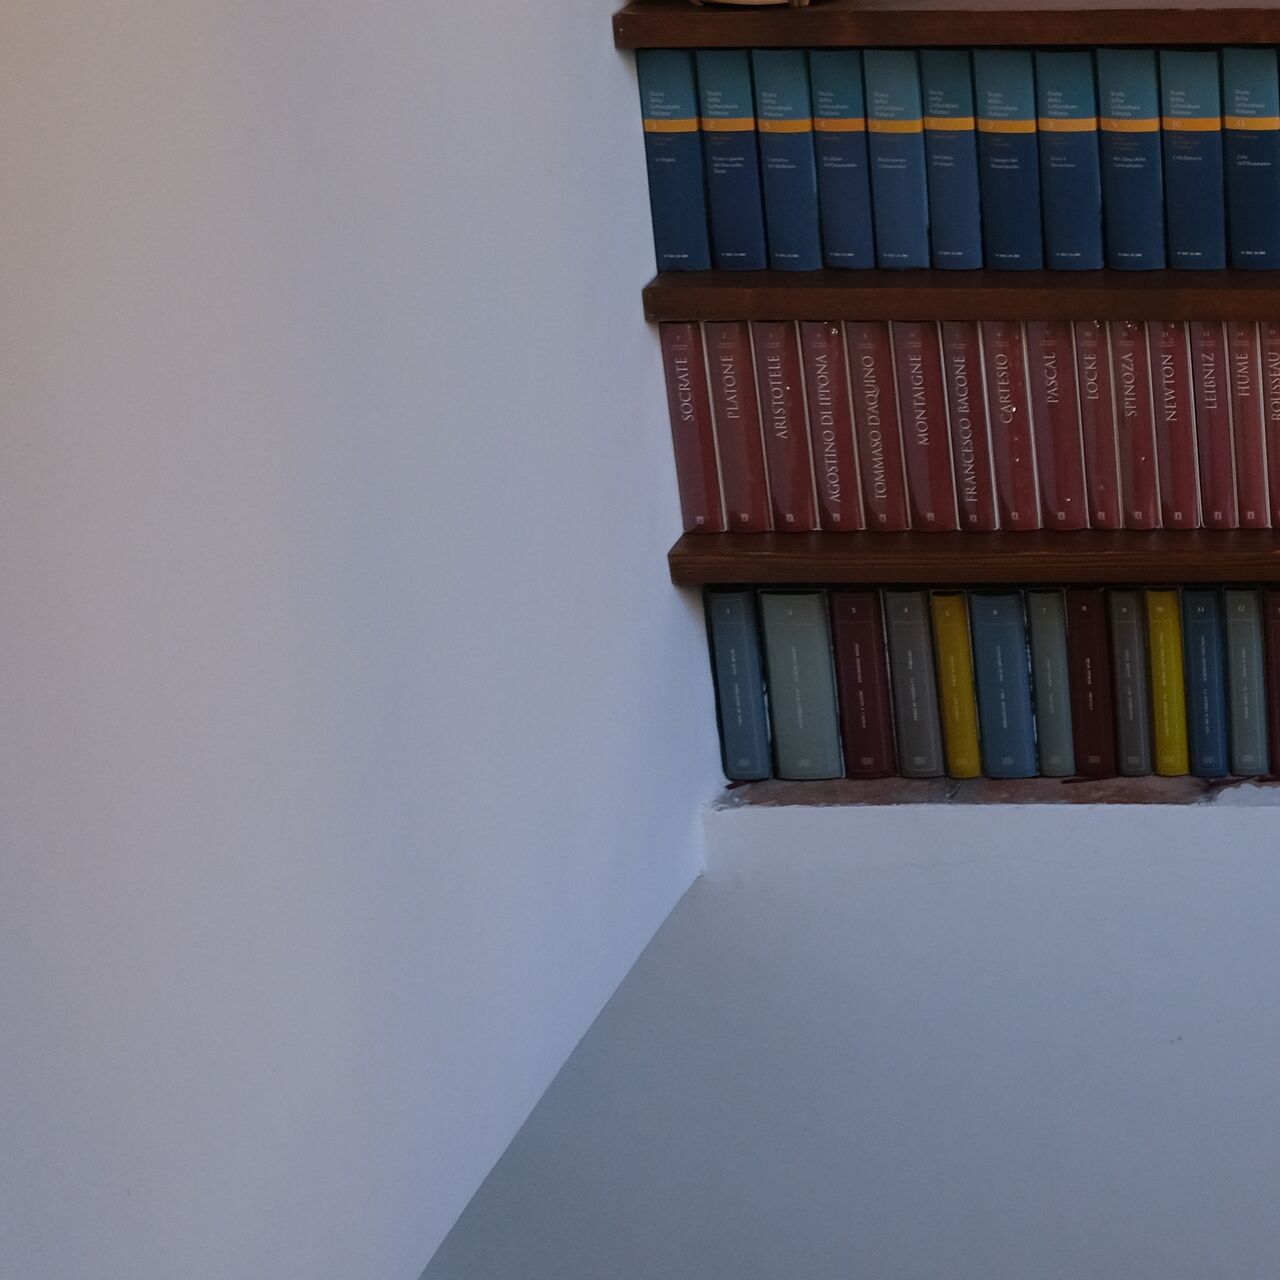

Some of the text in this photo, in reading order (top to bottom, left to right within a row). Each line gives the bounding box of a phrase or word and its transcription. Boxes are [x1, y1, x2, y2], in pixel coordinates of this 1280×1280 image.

[675, 356, 694, 422] SOCRATE
[720, 355, 740, 419] PLATONE
[767, 355, 788, 440] ARISTOTELE
[910, 354, 929, 446] MONTAIGNE
[995, 353, 1014, 424] CARTESIO
[1043, 352, 1059, 404] PASCAL
[1084, 353, 1099, 400] LOCKE
[1121, 352, 1137, 417] SPINOZA
[1161, 354, 1178, 422] NEWTON
[1202, 353, 1218, 409] LEIBNIZ
[1236, 353, 1251, 397] HUME
[816, 354, 840, 503] AGOSTINO DI IPPONA
[862, 355, 887, 499] TOMMASO D'AQUINO
[953, 355, 978, 502] FRANCESCO BACONE
